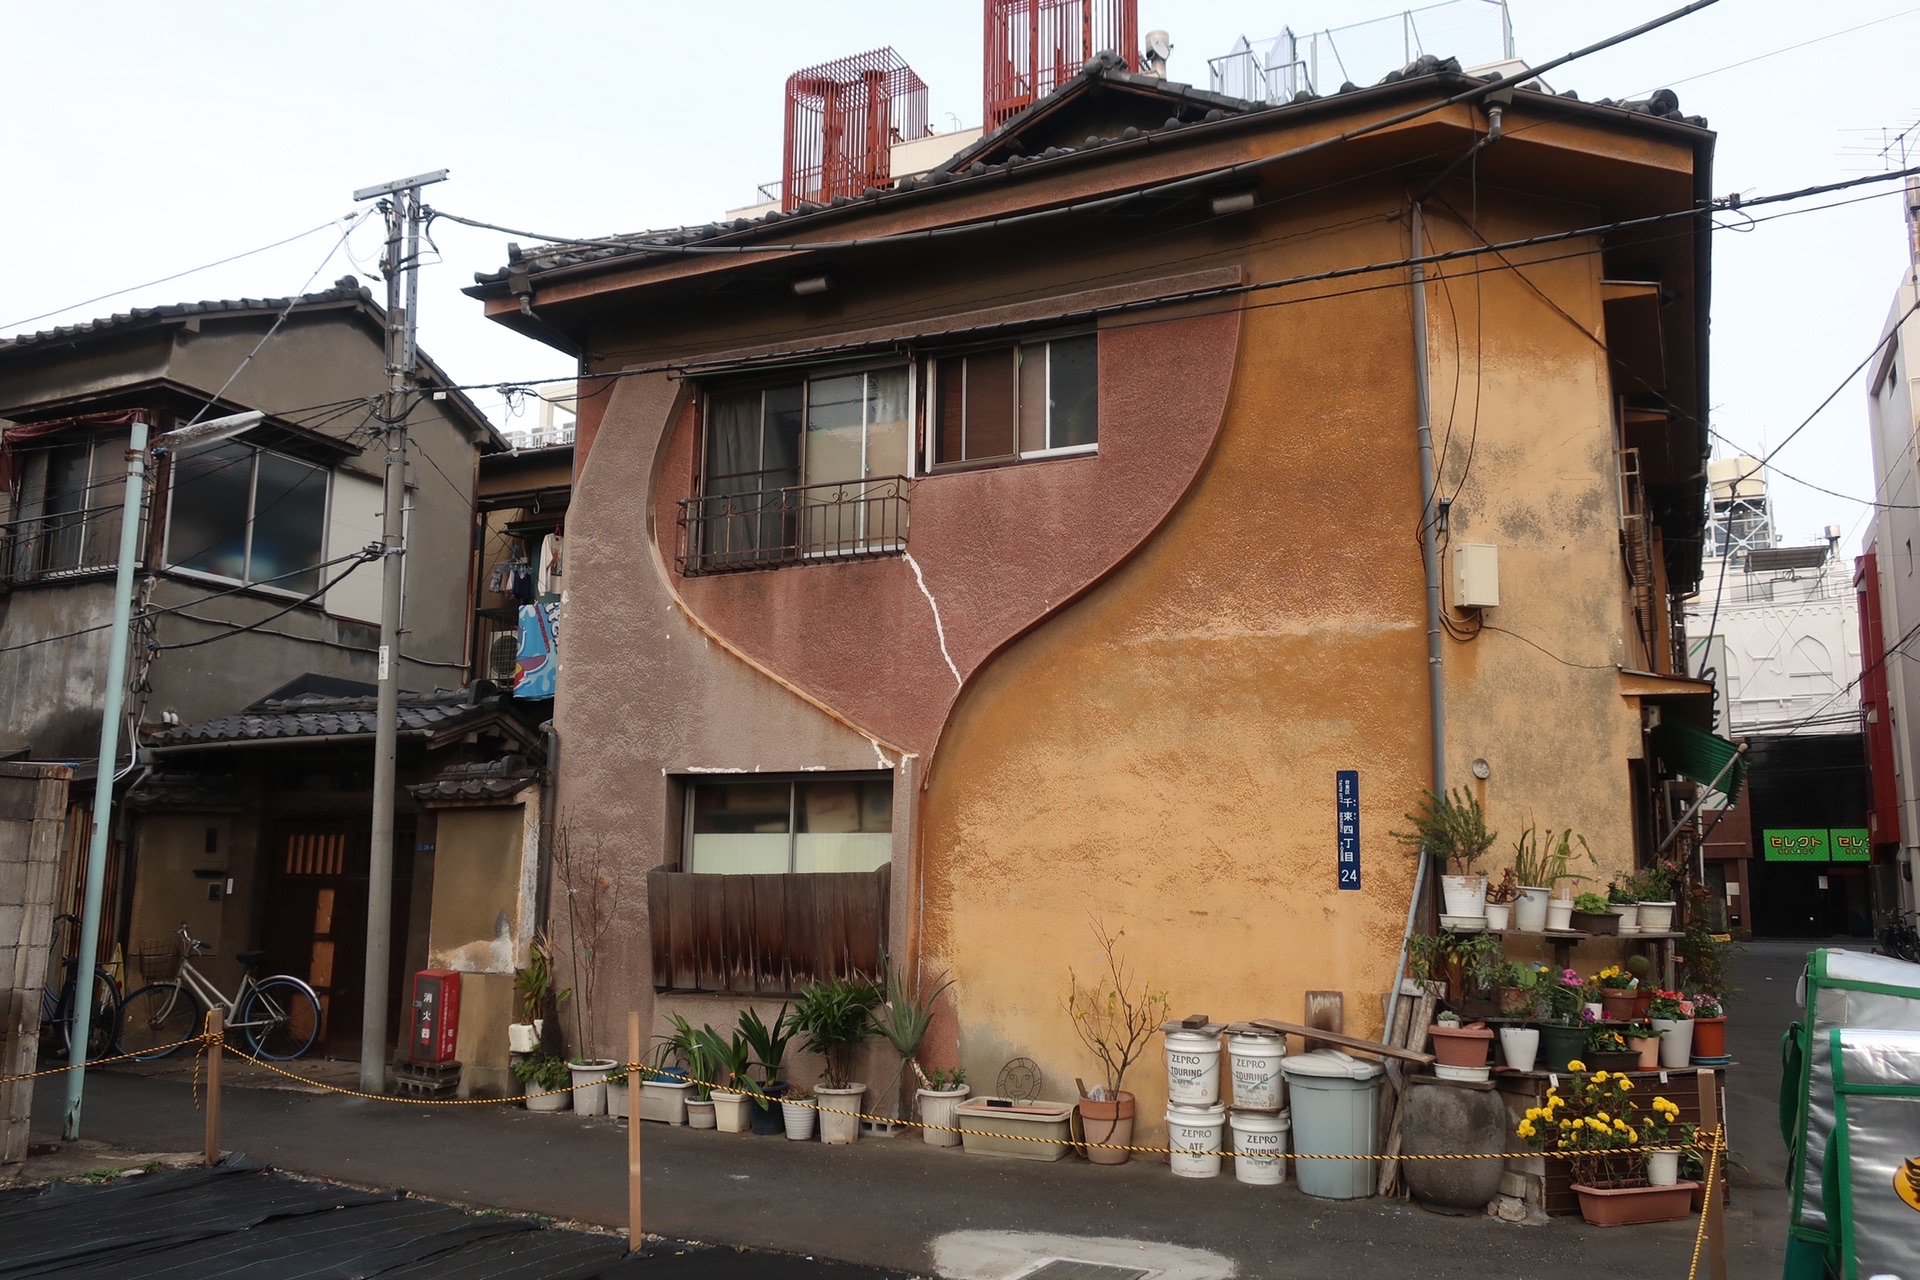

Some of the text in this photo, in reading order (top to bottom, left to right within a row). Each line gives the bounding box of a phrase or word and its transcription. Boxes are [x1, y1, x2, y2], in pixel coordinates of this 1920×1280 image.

[1770, 836, 1822, 848] セレクト
[1341, 869, 1358, 882] 24
[421, 992, 433, 1039] 消火器
[1171, 1054, 1201, 1065] ZEPRO
[1236, 1058, 1266, 1069] ZEPRO
[1170, 1066, 1203, 1078] TOURING
[1235, 1071, 1269, 1082] TOURING
[1181, 1128, 1212, 1139] ZEPRO
[1246, 1134, 1278, 1144] ZEPRO
[1189, 1142, 1204, 1151] ATF
[1244, 1147, 1280, 1156] TOURING
